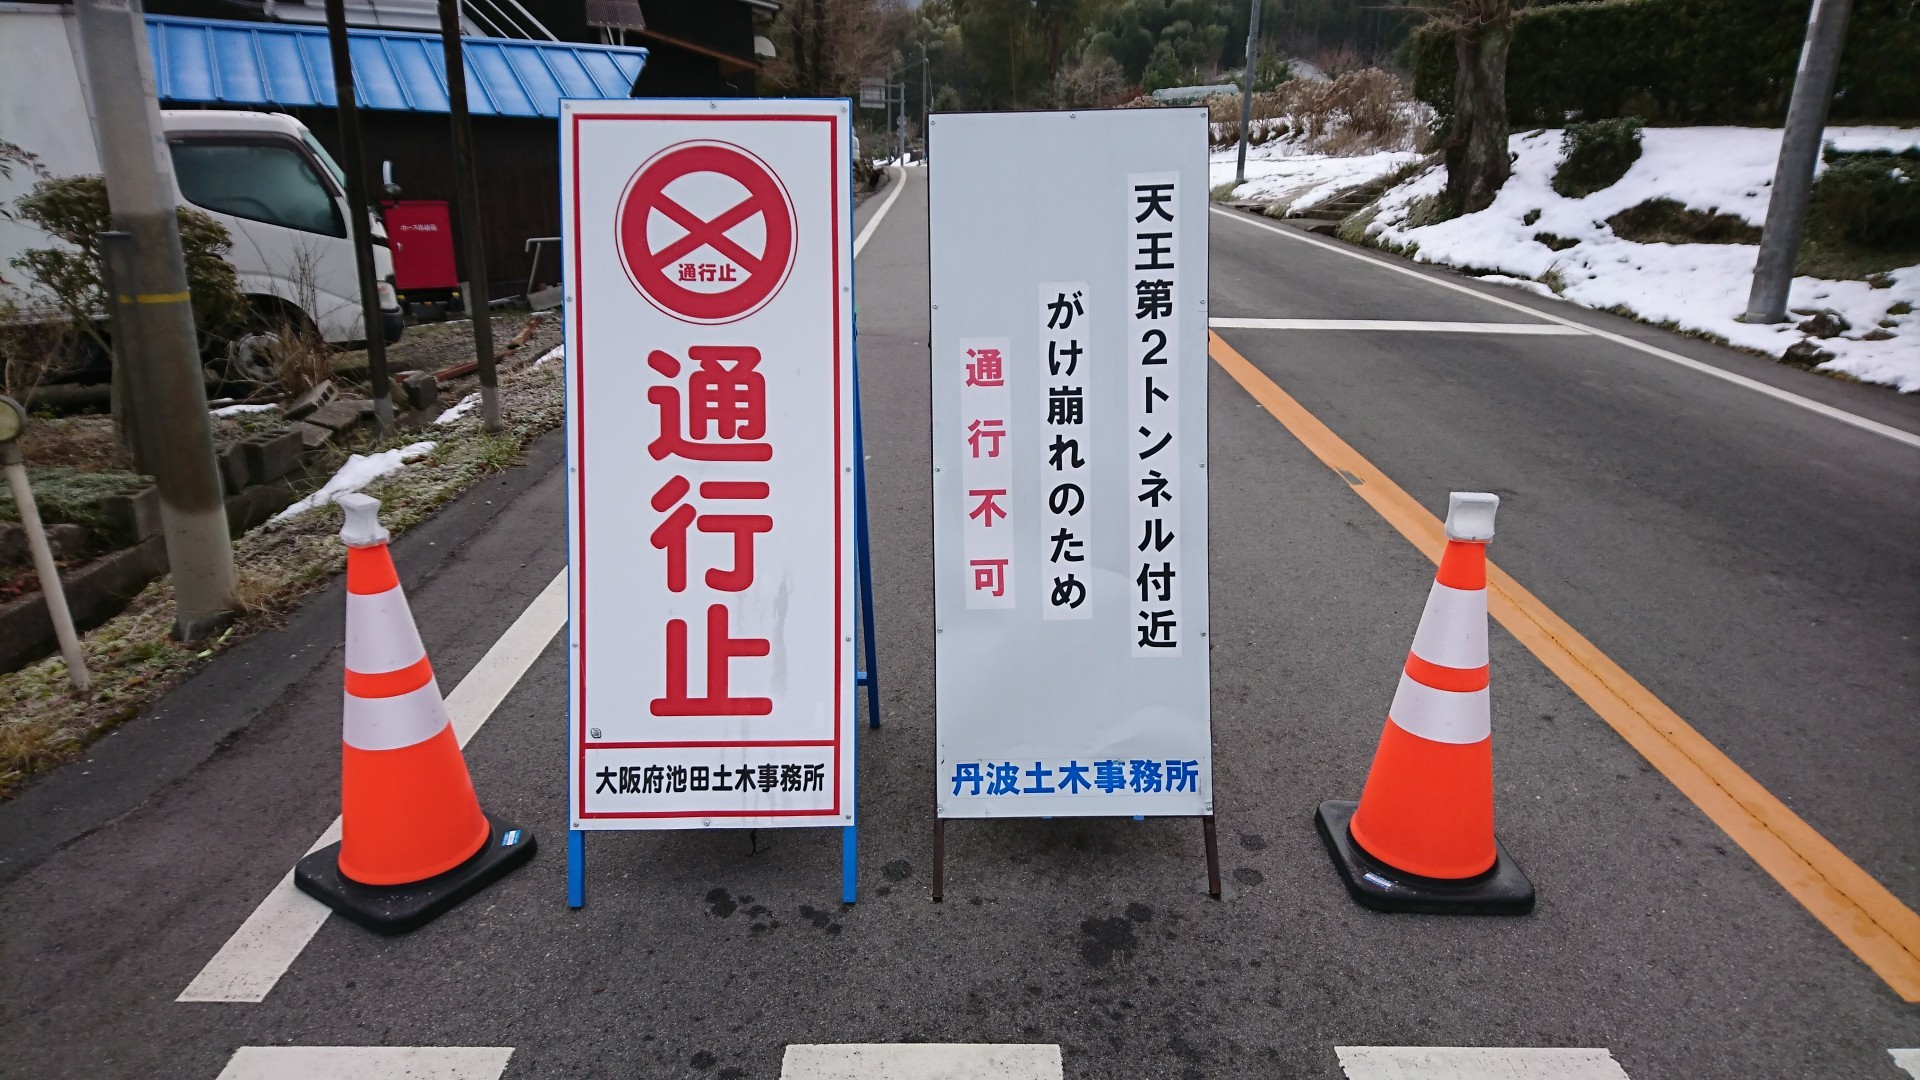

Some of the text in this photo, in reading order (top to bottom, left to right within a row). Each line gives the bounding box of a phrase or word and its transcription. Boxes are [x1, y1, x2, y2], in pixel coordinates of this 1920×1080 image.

[678, 263, 737, 282] 通行止
[648, 346, 774, 717] 通行止
[965, 348, 1009, 598] 通行不可
[1047, 291, 1087, 609] がけ崩れのため
[1134, 184, 1178, 647] 天王第2トンネル付近
[596, 763, 825, 795] 大阪府池田土木事務所
[951, 759, 1200, 798] 丹波土木事務所
